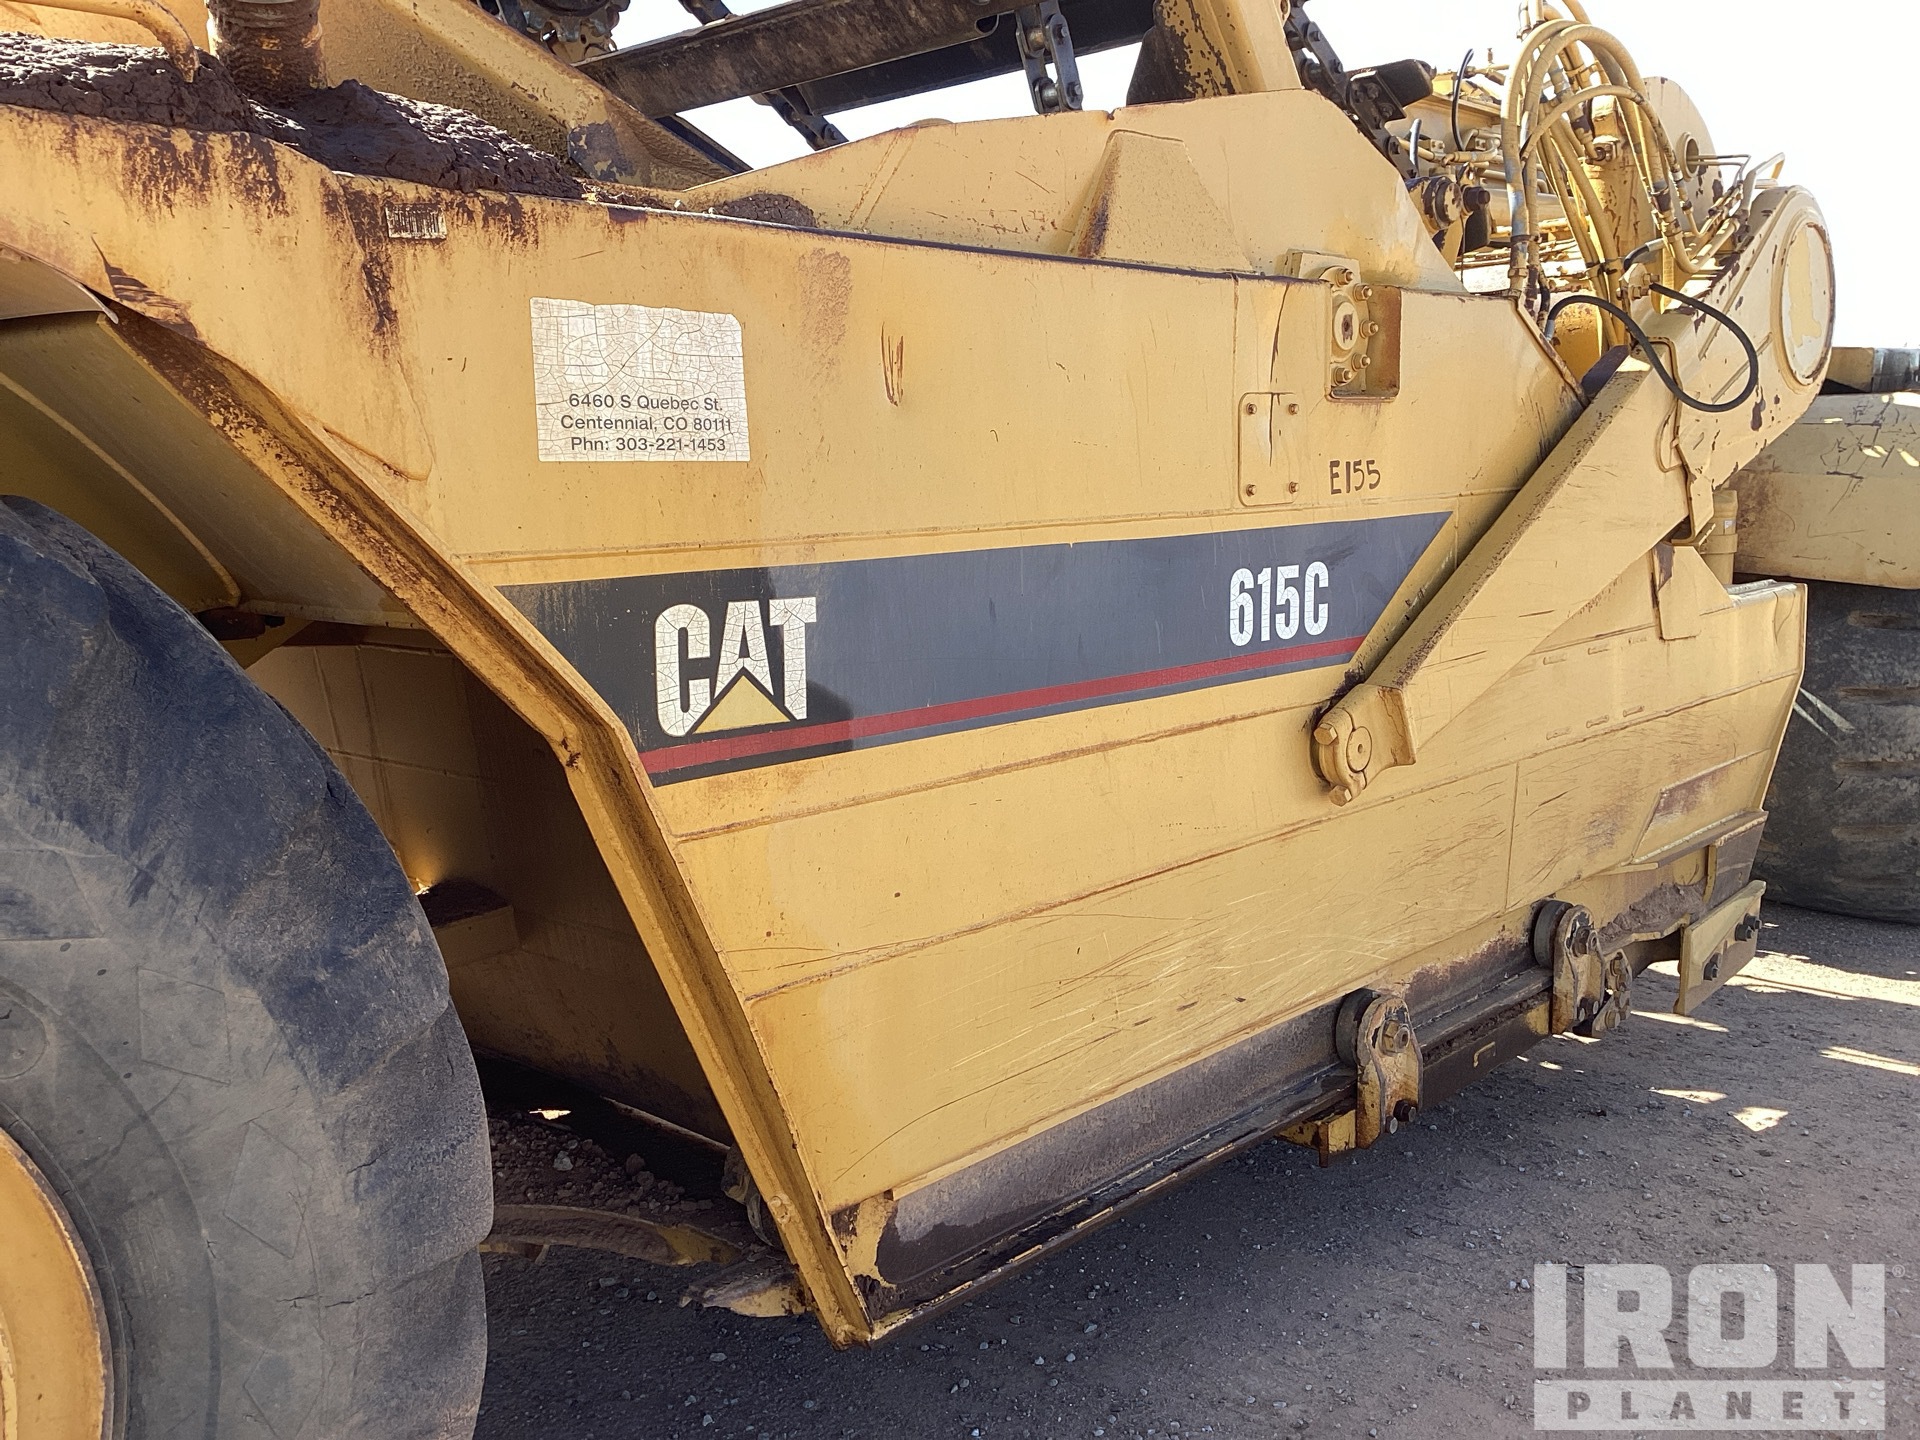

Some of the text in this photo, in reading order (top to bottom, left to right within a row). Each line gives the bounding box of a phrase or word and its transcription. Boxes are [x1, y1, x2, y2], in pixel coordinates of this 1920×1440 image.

[568, 393, 723, 411] 6460 S Quebec St.
[560, 414, 731, 432] Centennial, CO 80111
[571, 437, 726, 451] Phn: 303-221-1453
[1329, 460, 1381, 495] E155
[1229, 561, 1329, 647] 615C
[655, 596, 817, 738] CAT
